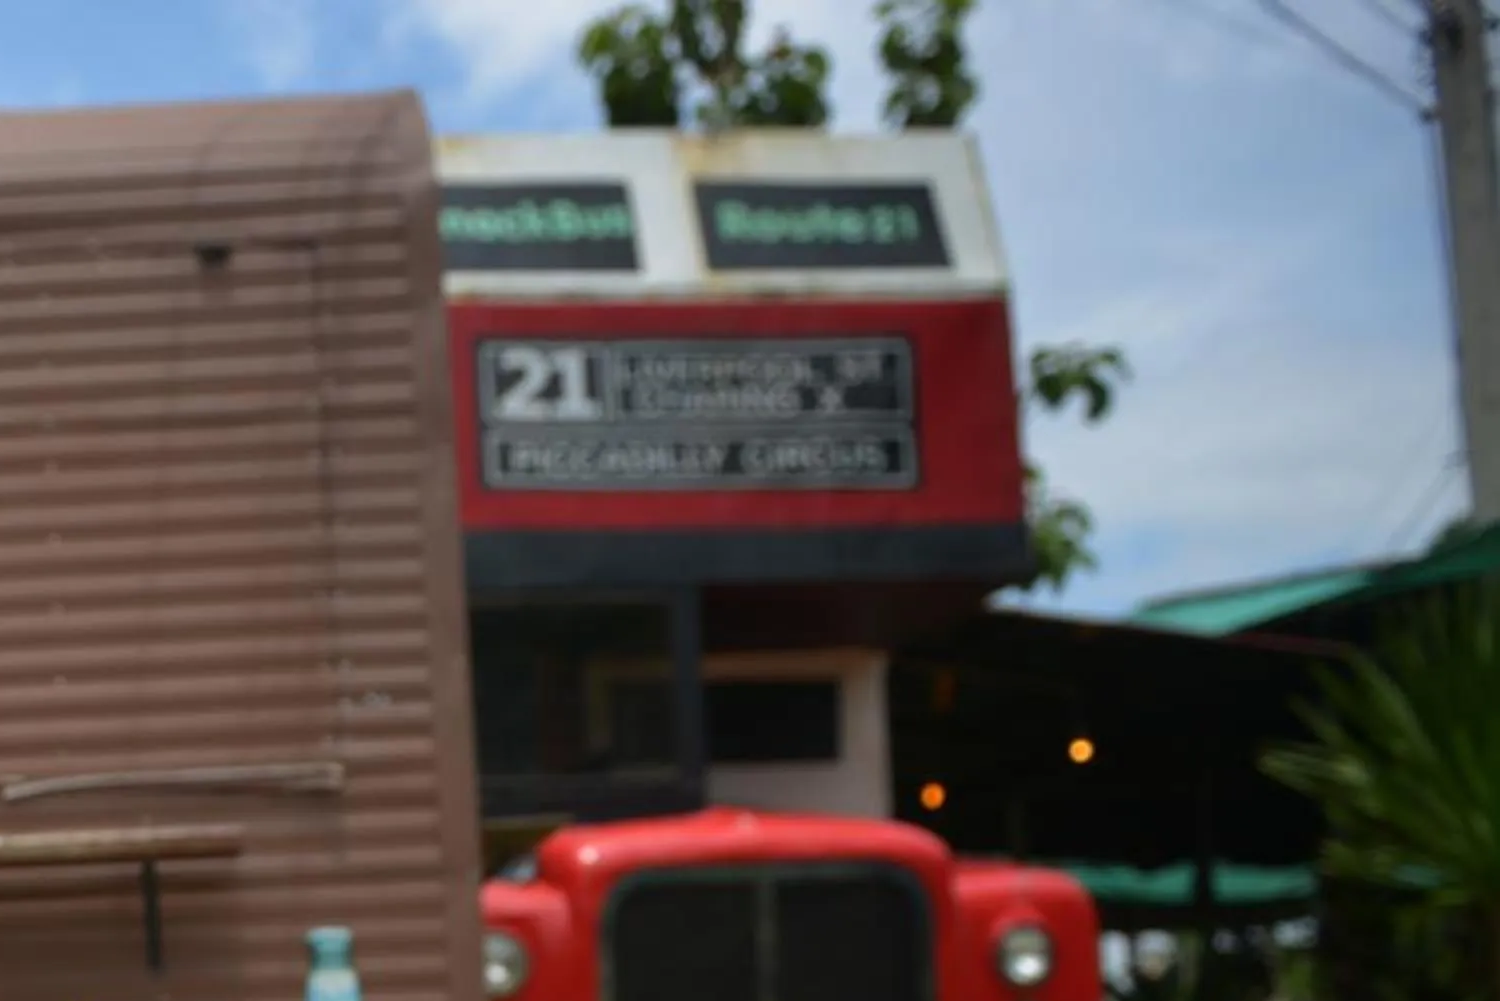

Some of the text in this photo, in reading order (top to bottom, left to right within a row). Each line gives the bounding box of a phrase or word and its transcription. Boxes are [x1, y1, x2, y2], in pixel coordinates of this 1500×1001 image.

[869, 203, 920, 241] 21
[495, 347, 600, 421] 21
[508, 438, 887, 476] PICCADILLY CIRCUS
